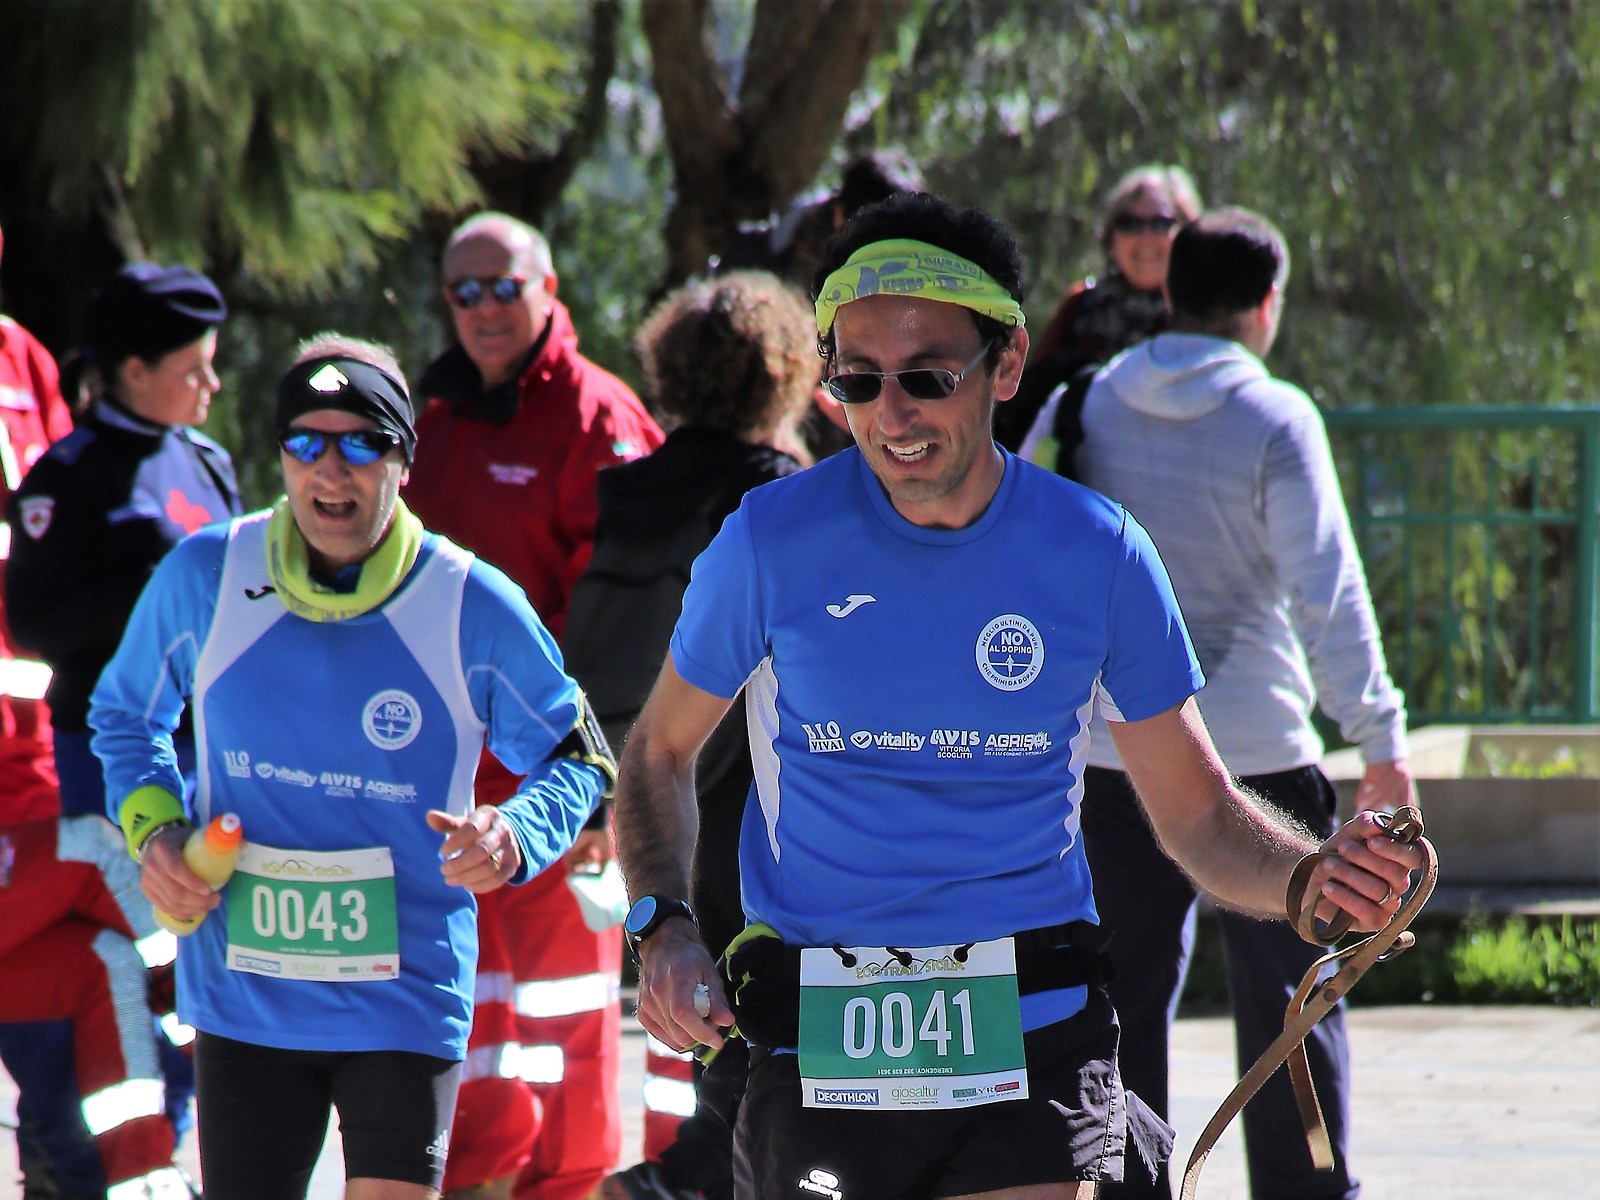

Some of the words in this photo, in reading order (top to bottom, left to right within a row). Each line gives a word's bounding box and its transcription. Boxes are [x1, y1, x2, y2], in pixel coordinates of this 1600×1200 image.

[981, 623, 1000, 647] MEGLIO
[1000, 619, 1022, 627] ULTIMI
[1001, 631, 1024, 646] NO
[989, 645, 1000, 653] AL
[1001, 645, 1032, 654] DOPING
[982, 662, 992, 676] CHE
[385, 702, 406, 717] NO
[873, 731, 926, 752] vitality
[930, 729, 980, 741] AVIS
[811, 740, 844, 751] VIVAI
[320, 771, 363, 789] AVIS
[252, 885, 368, 942] 0043
[843, 989, 975, 1059] 0041
[817, 1091, 876, 1103] DECATHLON
[891, 1085, 940, 1101] giosaltur
